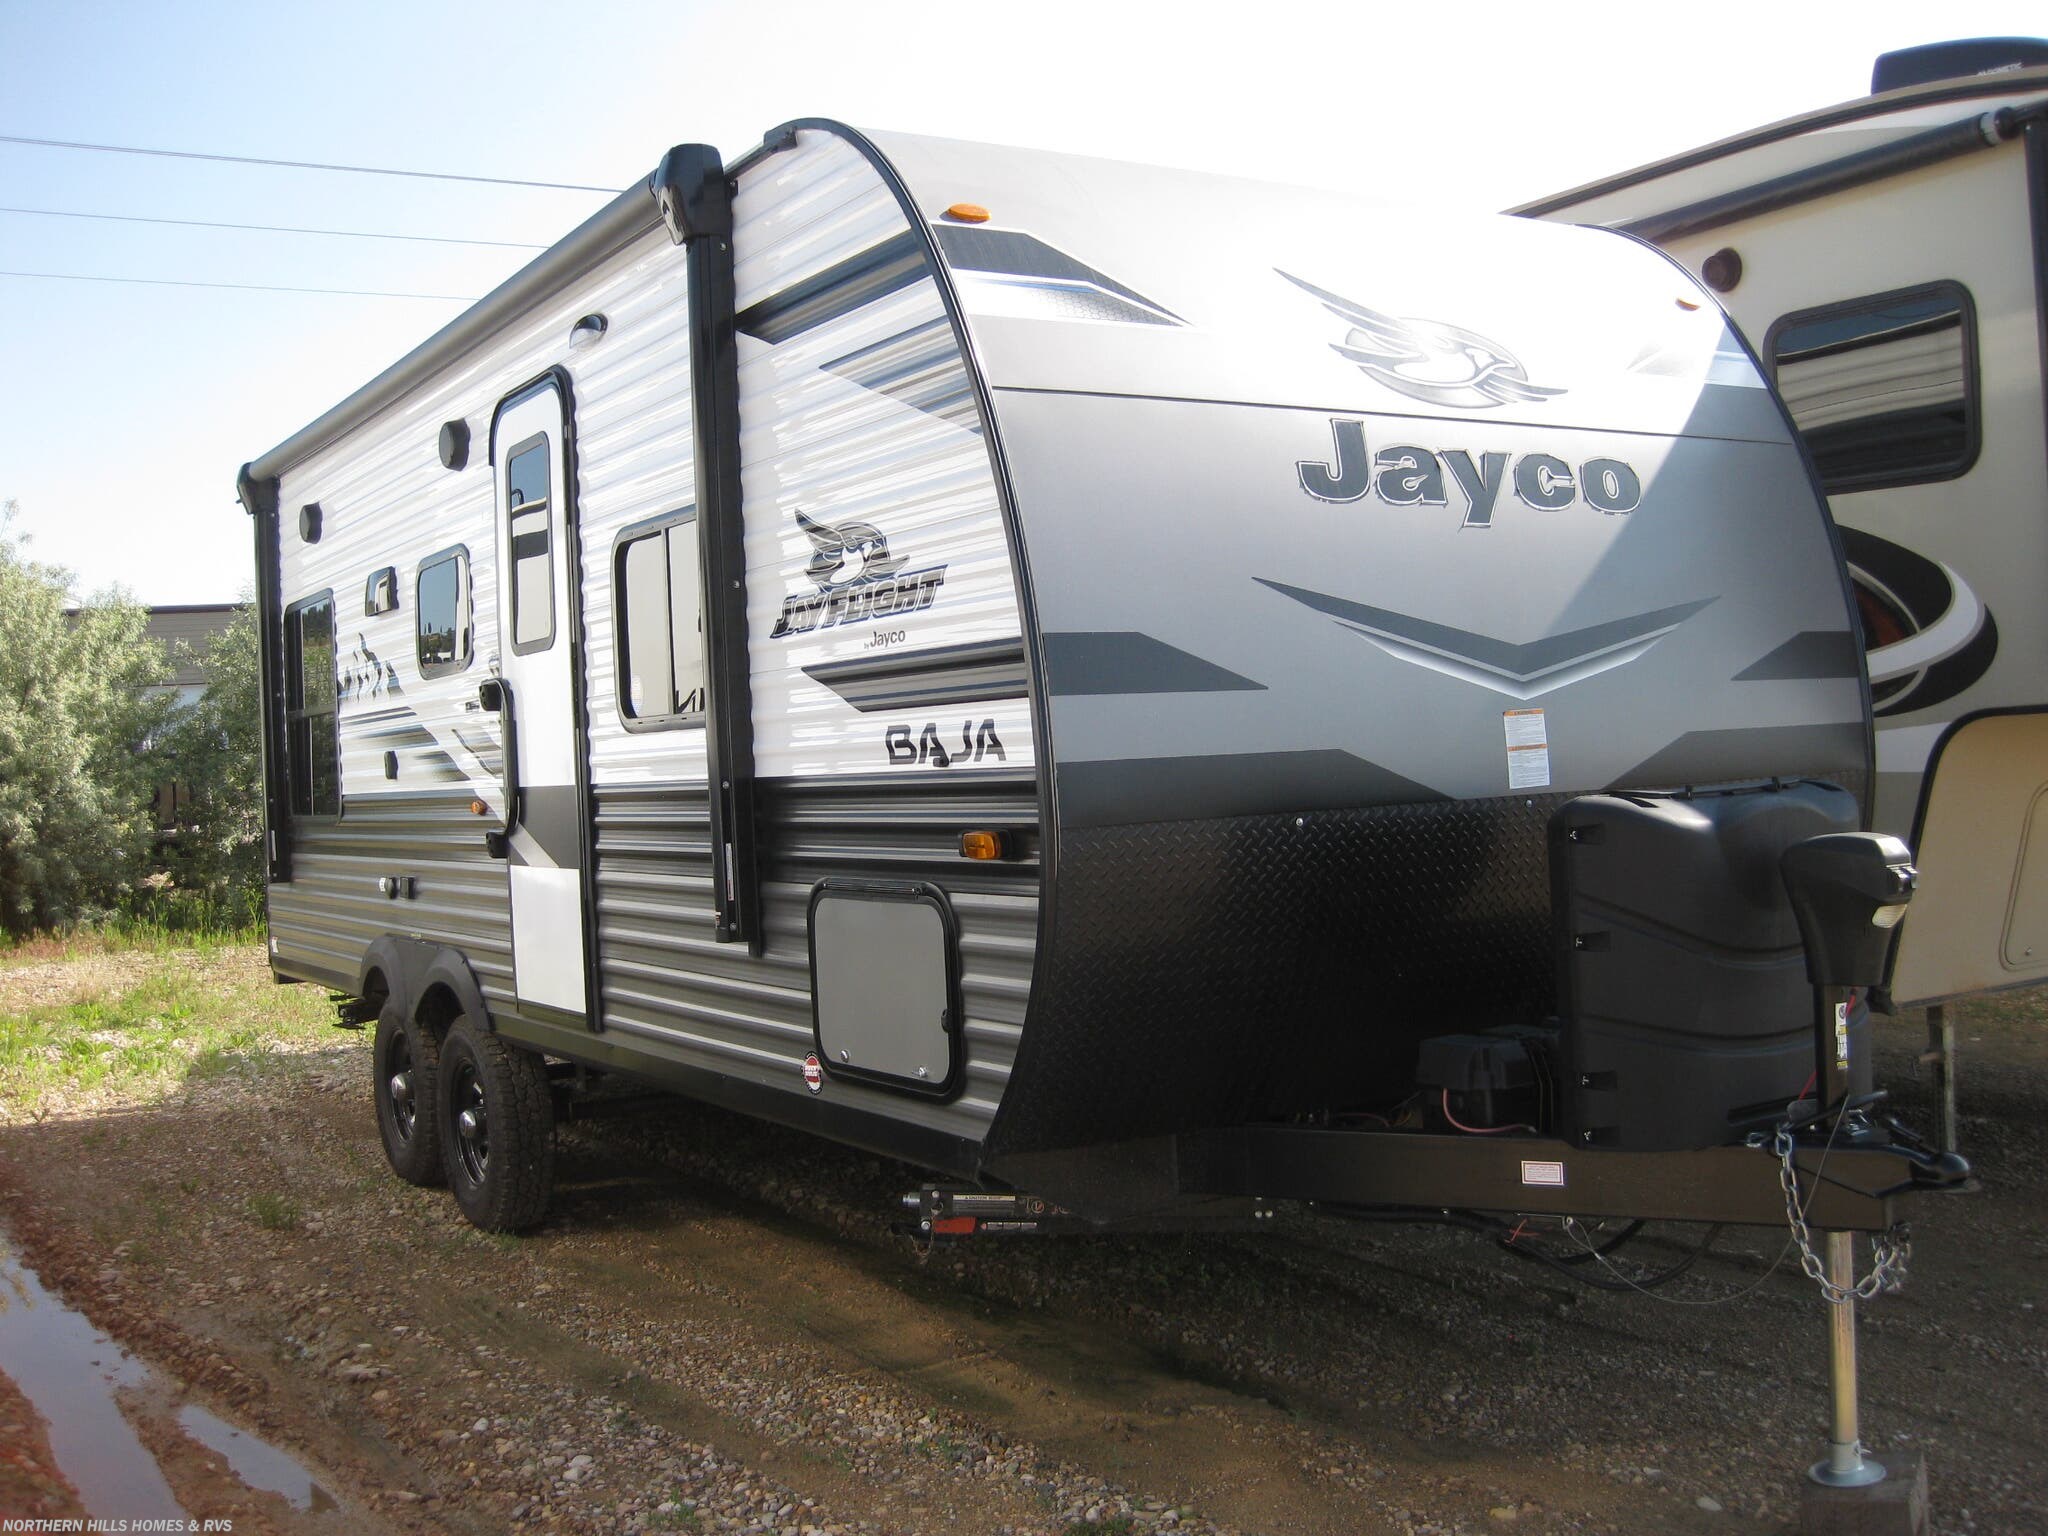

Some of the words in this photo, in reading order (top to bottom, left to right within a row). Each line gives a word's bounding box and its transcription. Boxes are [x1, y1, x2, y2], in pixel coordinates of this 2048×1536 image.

[1297, 418, 1642, 530] Jayco
[870, 630, 906, 650] Jayco
[885, 719, 1007, 768] BAJA
